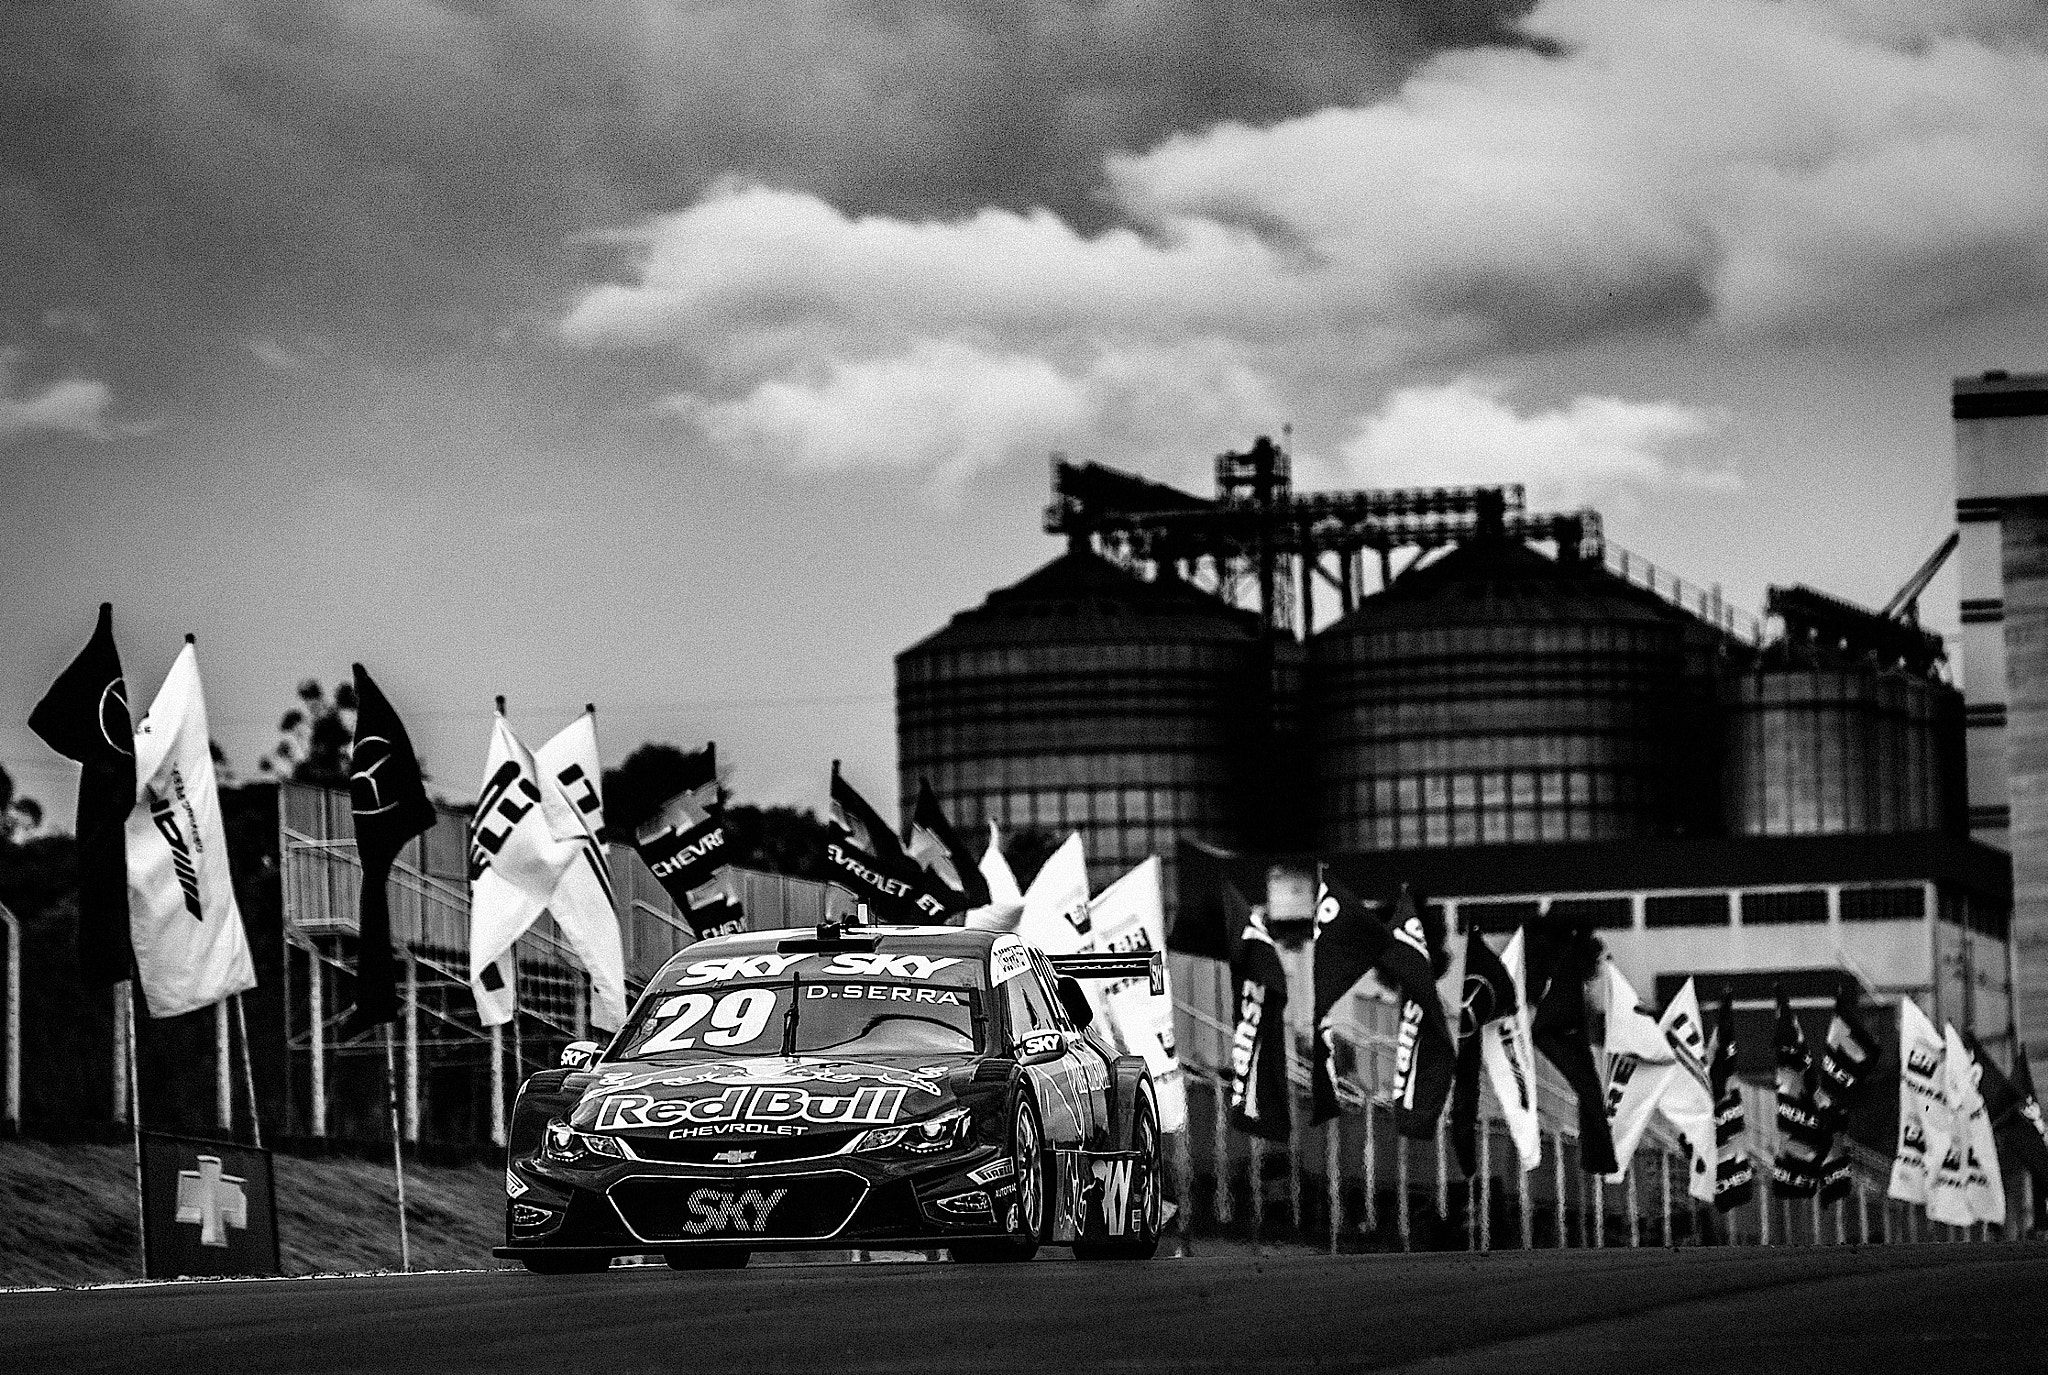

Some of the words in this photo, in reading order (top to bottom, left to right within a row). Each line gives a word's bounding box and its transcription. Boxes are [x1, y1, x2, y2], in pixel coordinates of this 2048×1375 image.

[675, 953, 815, 986] SKY
[822, 952, 964, 980] SKY
[805, 985, 960, 1007] D.SERRA
[638, 988, 777, 1055] 29
[1026, 1034, 1060, 1054] SKY
[560, 1050, 590, 1067] SKY
[594, 1086, 752, 1131] Red
[745, 1086, 908, 1124] Bull
[668, 1123, 808, 1140] CHEVROLET
[683, 1188, 788, 1235] SKY
